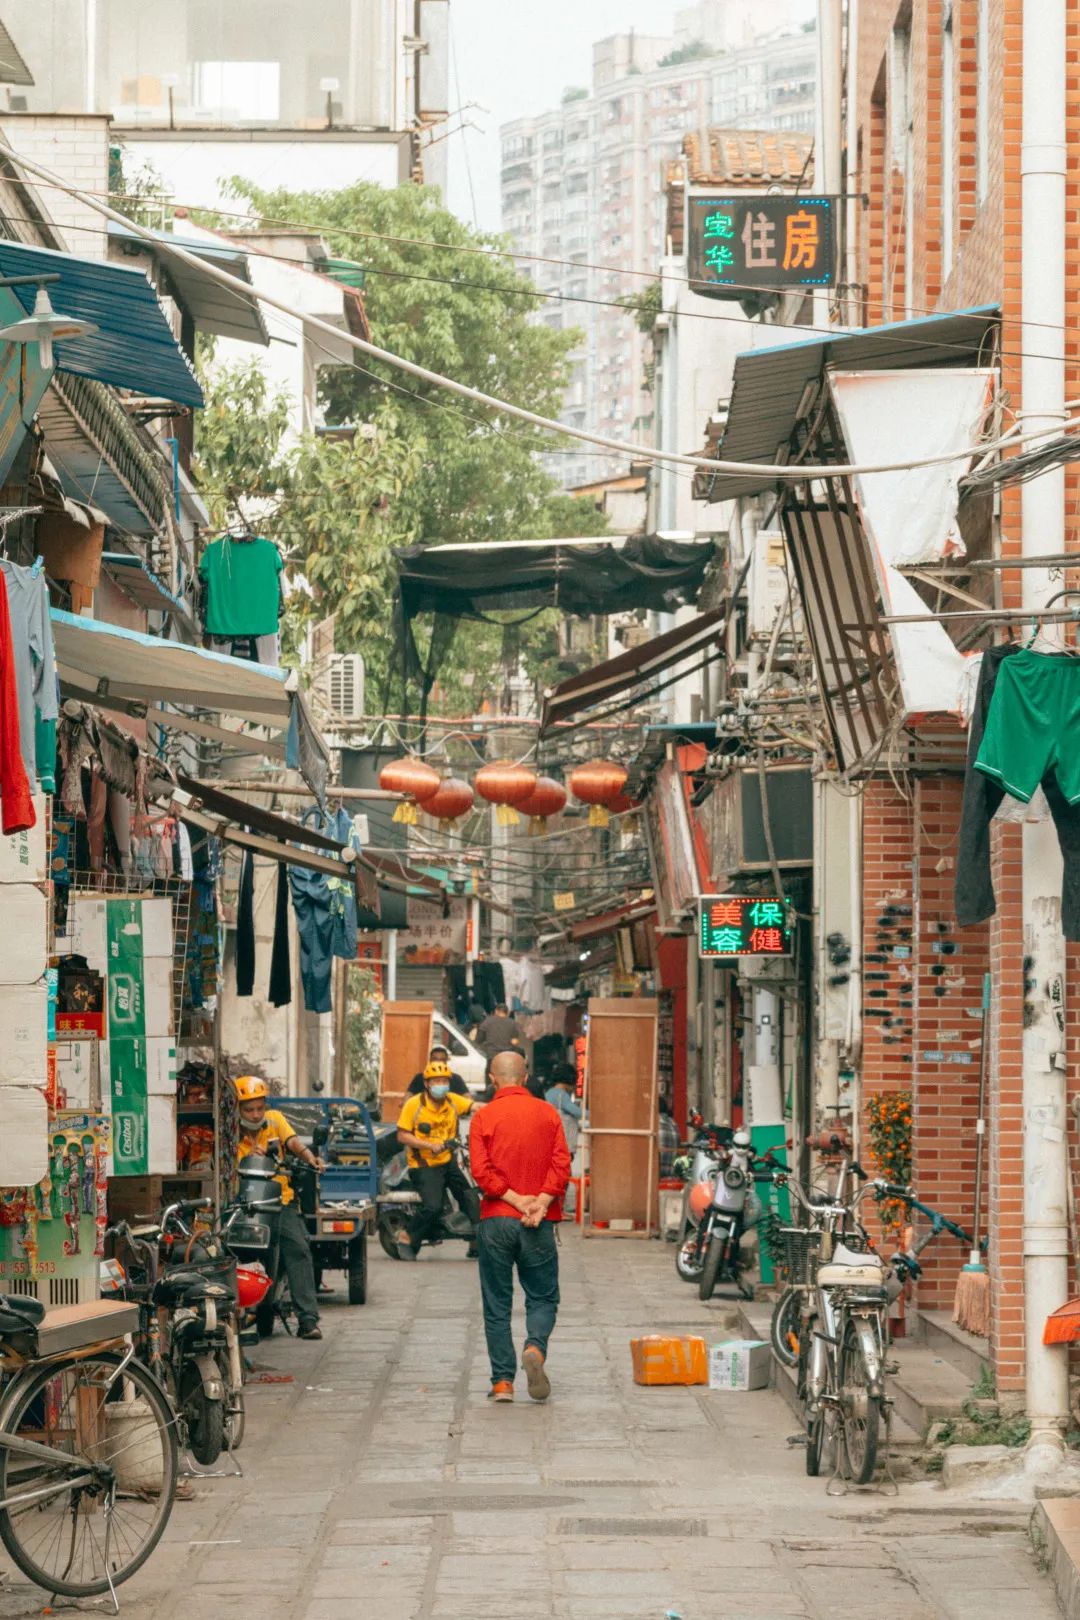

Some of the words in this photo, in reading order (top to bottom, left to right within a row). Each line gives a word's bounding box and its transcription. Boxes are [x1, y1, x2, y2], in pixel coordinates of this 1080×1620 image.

[704, 211, 734, 273] 宝华
[741, 209, 820, 271] 住房
[711, 902, 743, 952] 美容
[749, 902, 783, 952] 保健
